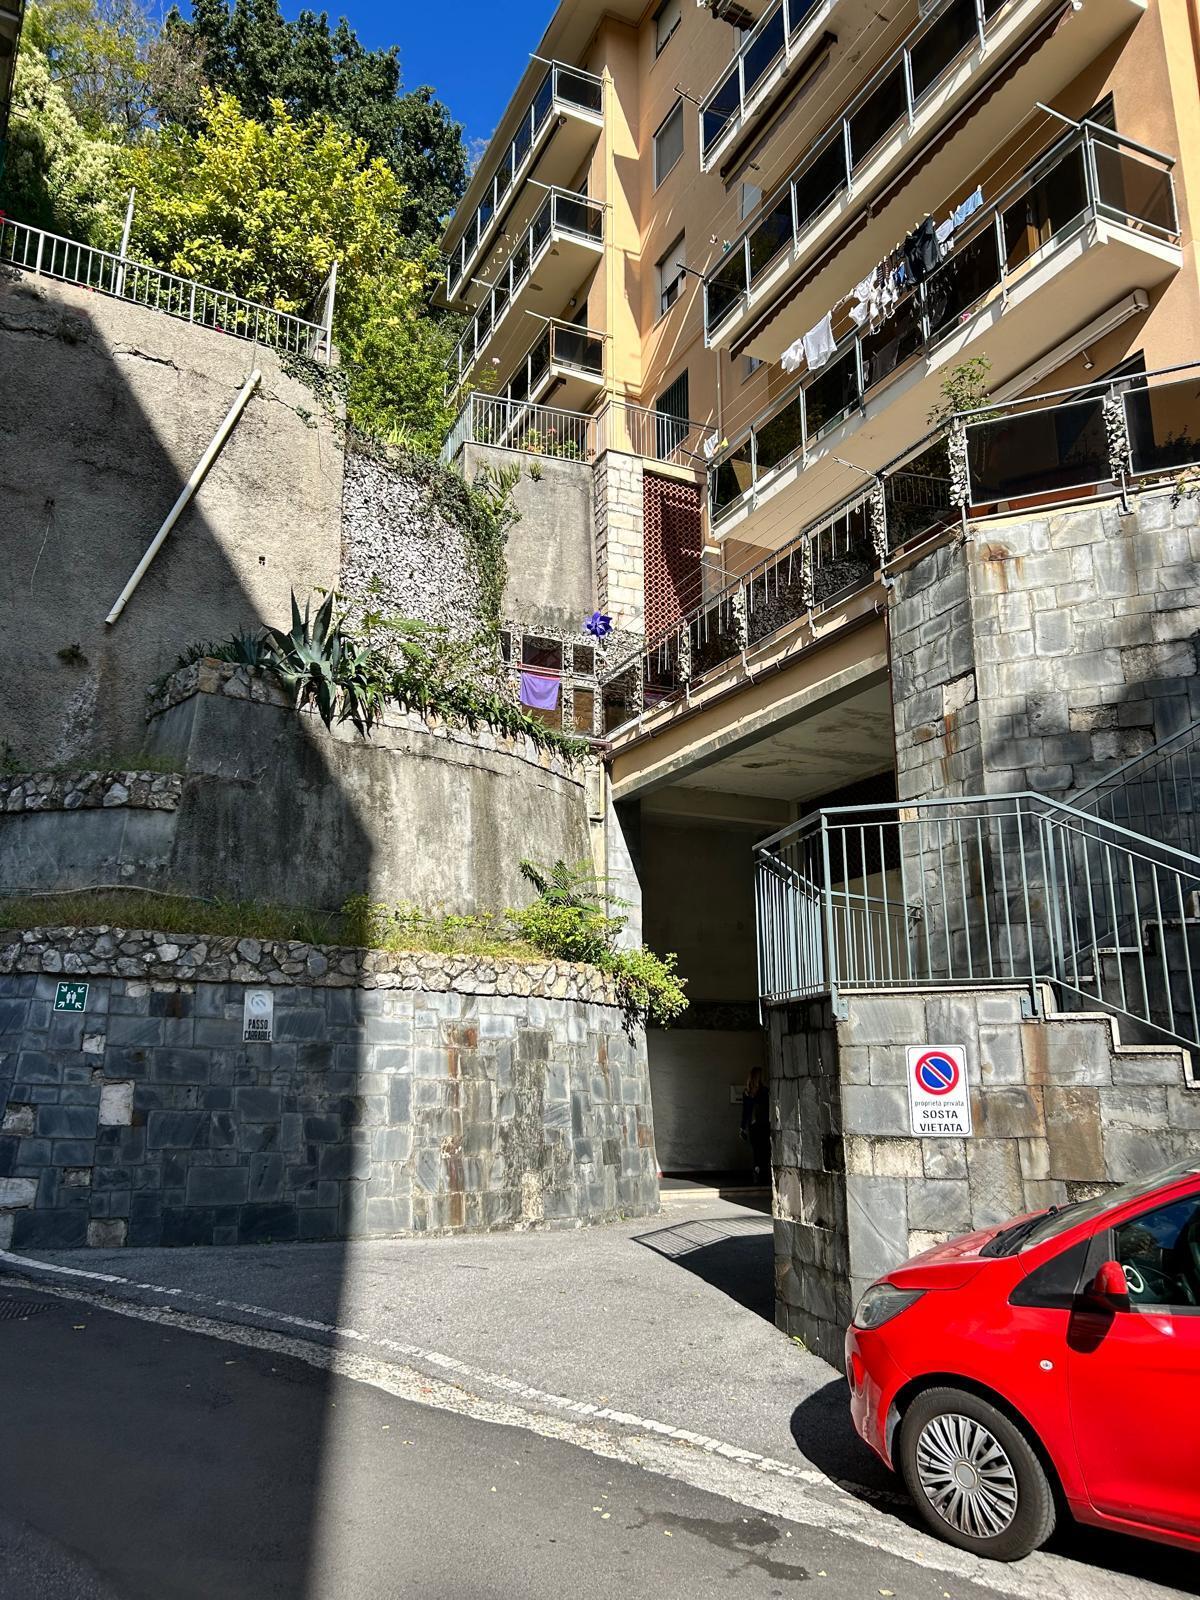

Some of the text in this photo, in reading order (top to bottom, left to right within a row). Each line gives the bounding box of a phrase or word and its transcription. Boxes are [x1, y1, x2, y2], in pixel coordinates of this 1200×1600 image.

[248, 1018, 268, 1030] PASSO
[244, 1030, 271, 1041] CARRABILE
[922, 1110, 958, 1119] SOSTA
[919, 1123, 963, 1132] VIETATA
